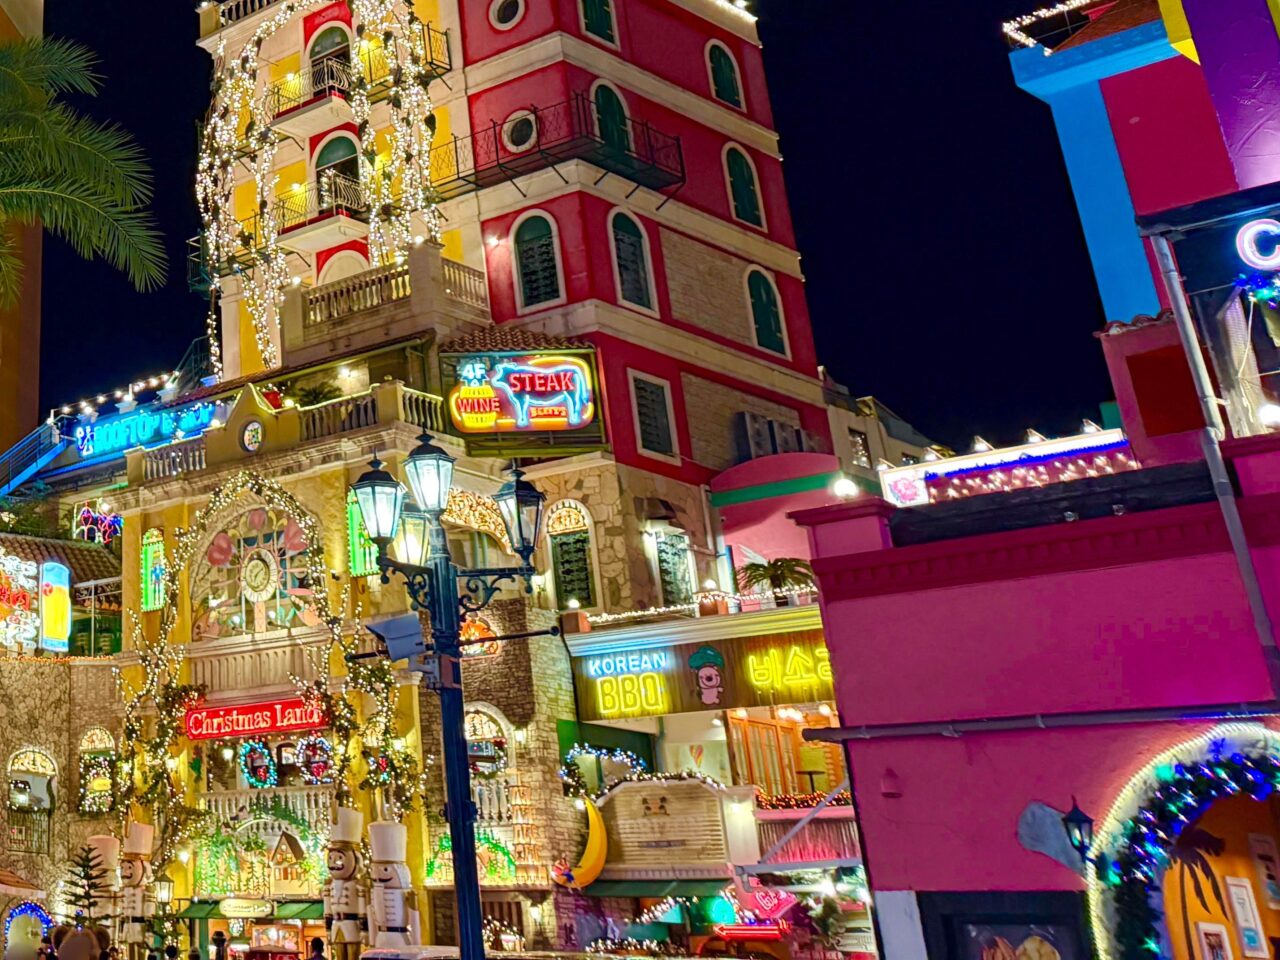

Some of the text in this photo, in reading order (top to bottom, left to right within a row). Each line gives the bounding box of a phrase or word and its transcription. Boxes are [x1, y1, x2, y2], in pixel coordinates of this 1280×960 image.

[462, 363, 486, 379] 4F
[509, 371, 574, 392] STEAK
[457, 397, 501, 413] WINE
[93, 412, 160, 453] ROOFTOP
[589, 652, 666, 676] KOREAN
[596, 671, 663, 714] BBQ
[189, 702, 320, 735] Christmas Land
